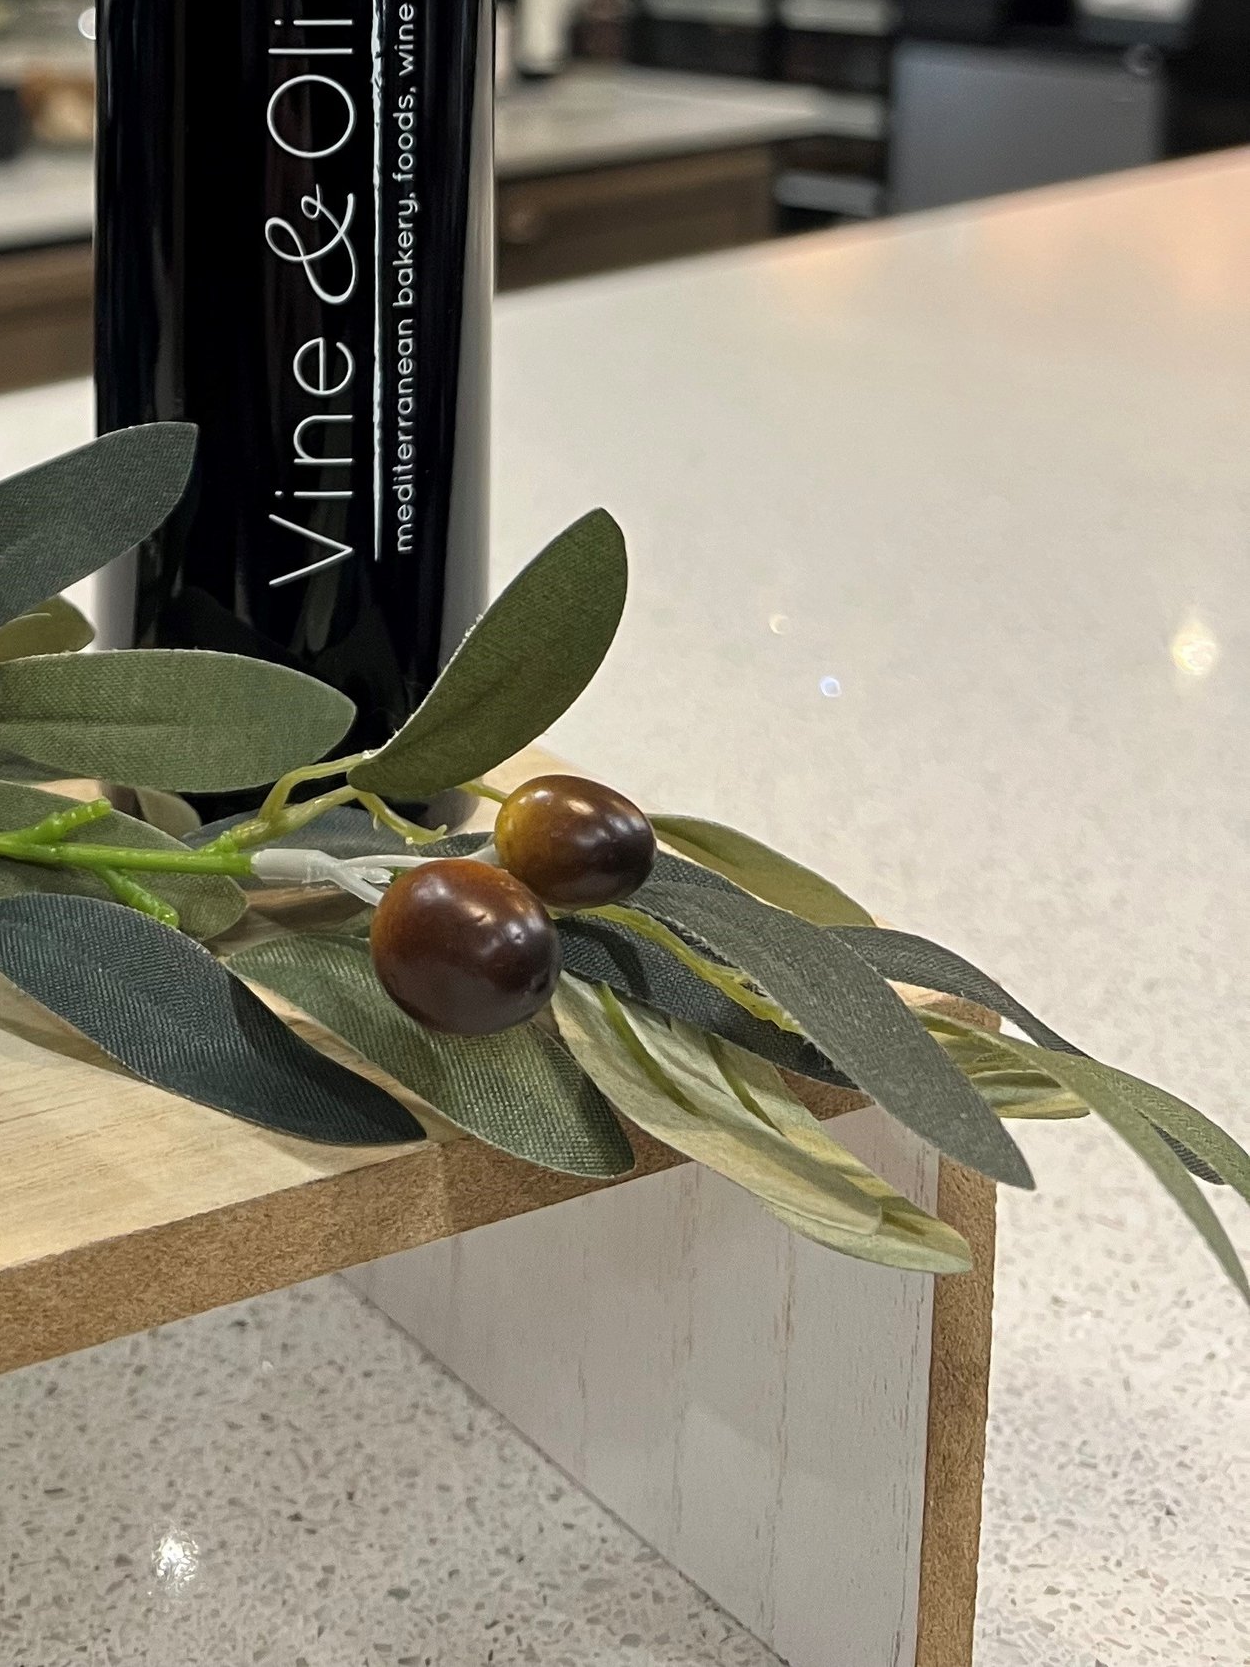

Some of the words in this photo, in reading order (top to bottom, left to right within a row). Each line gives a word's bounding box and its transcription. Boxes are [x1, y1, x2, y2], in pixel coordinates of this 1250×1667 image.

[393, 2, 416, 77] wine
[391, 86, 417, 183] foods,
[263, 183, 356, 305] &
[391, 191, 420, 308] bakery,
[268, 335, 354, 587] Vine
[391, 317, 414, 554] mediterranean
